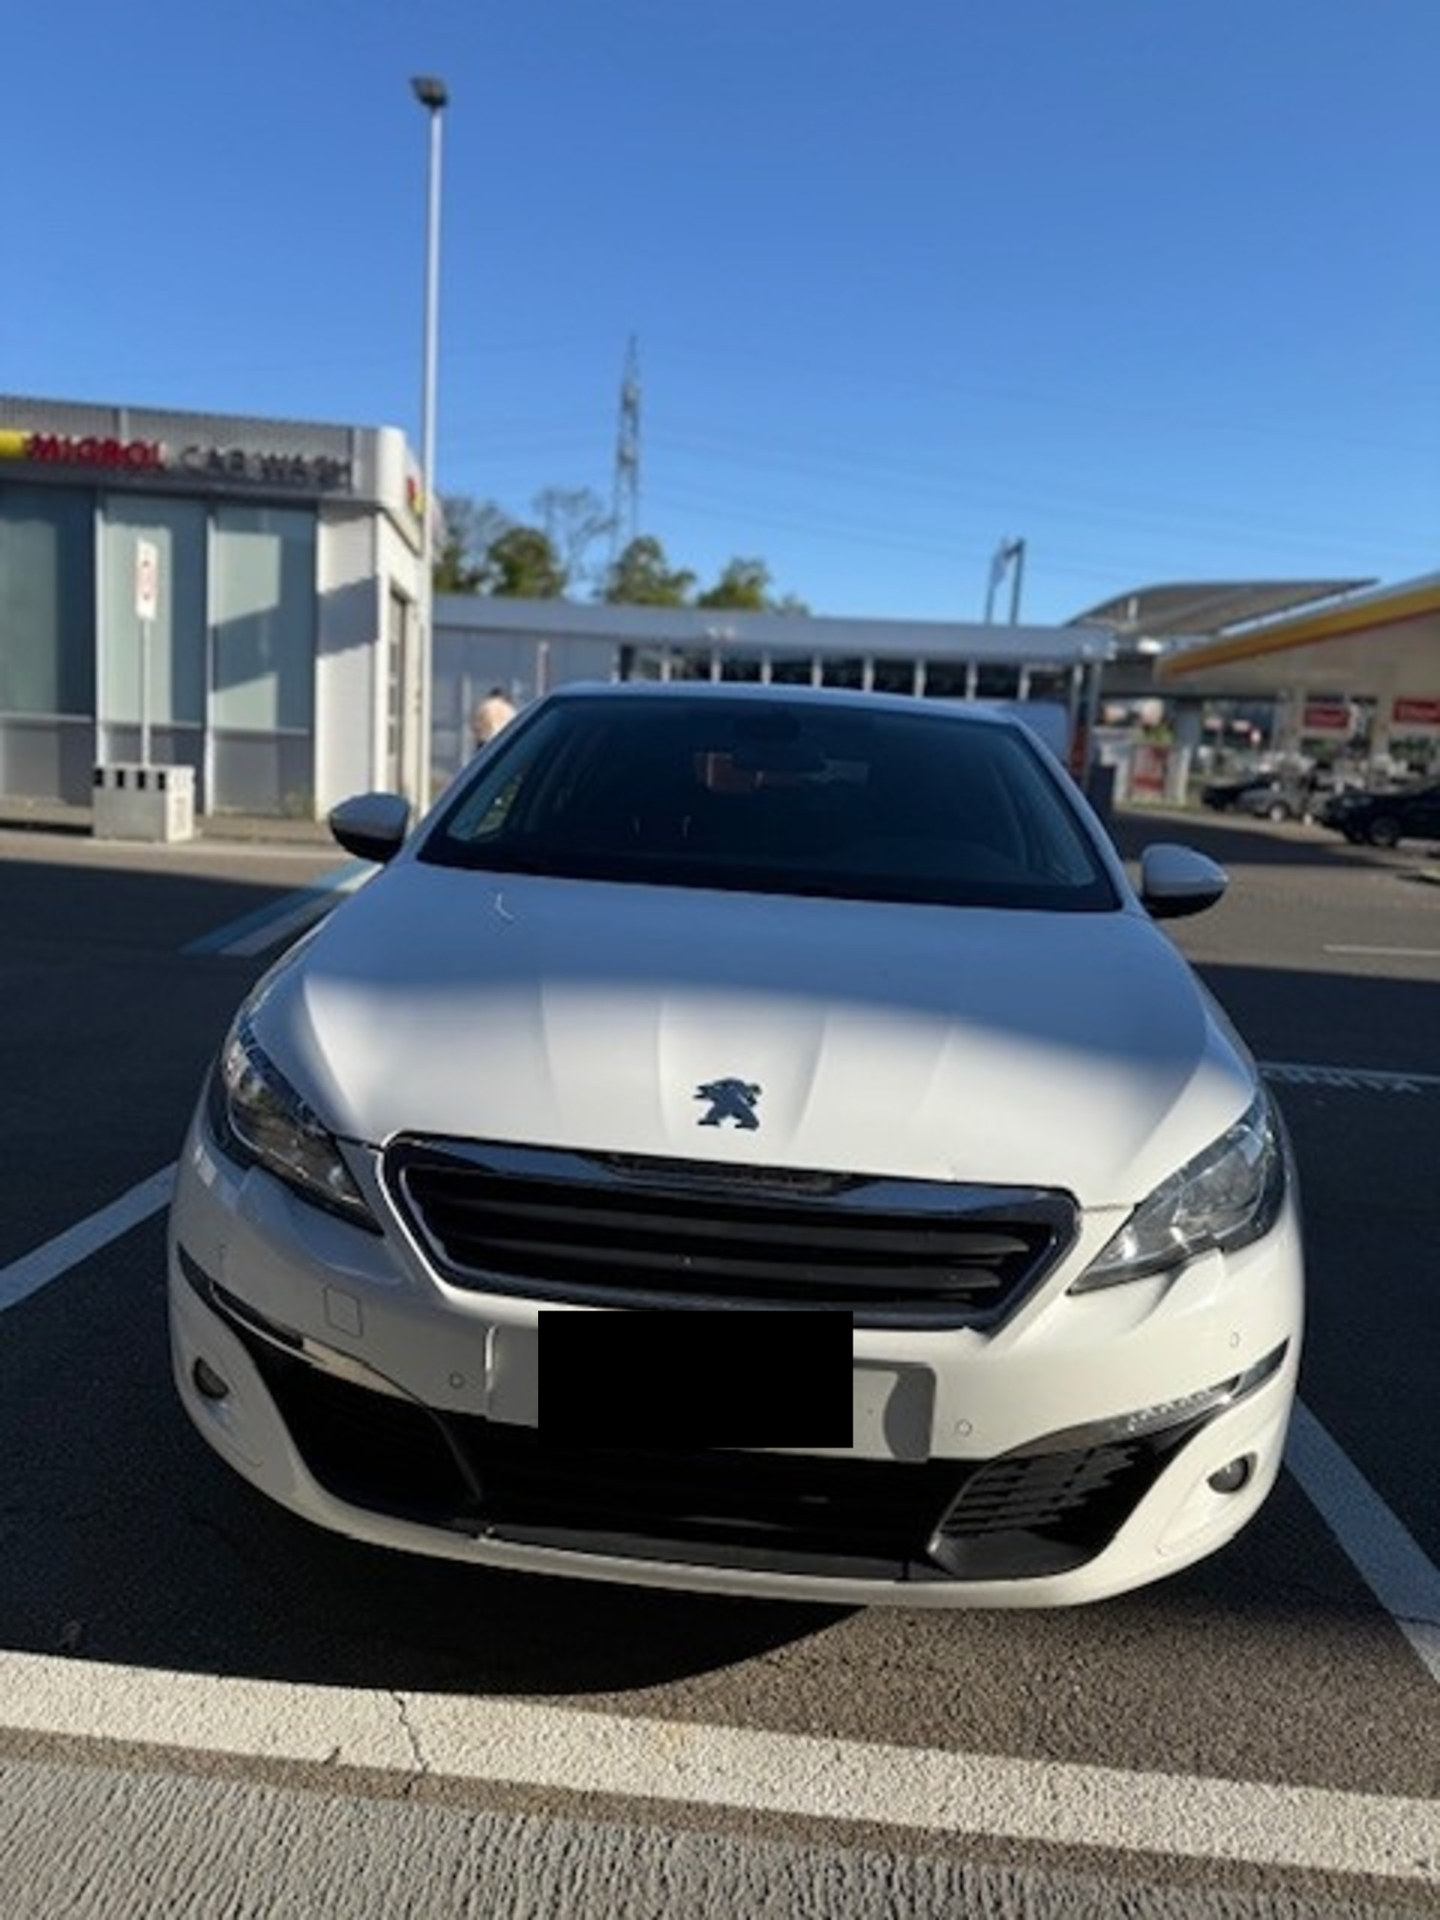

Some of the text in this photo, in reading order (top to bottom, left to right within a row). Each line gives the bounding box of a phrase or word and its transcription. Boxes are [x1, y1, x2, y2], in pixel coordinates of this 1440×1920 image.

[26, 431, 351, 486] MIGROL CAR WASH
